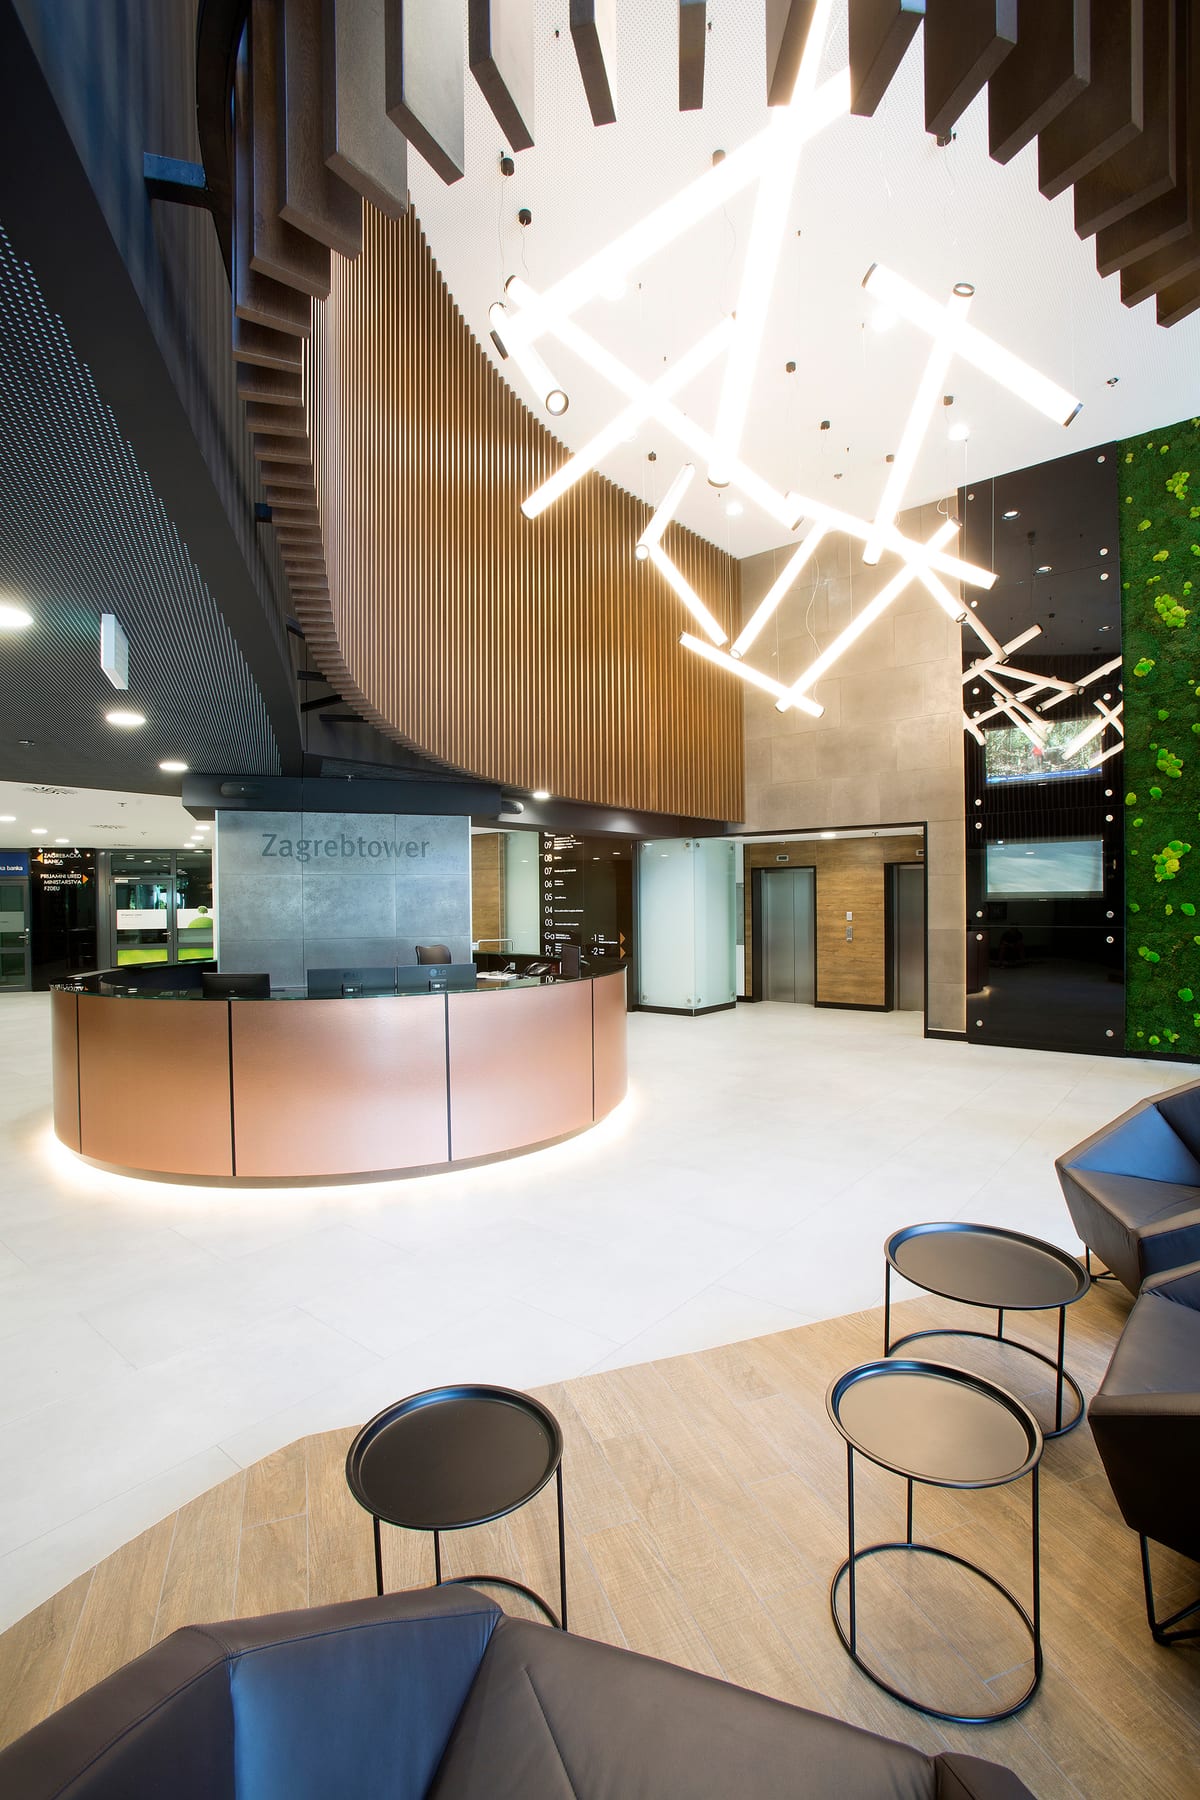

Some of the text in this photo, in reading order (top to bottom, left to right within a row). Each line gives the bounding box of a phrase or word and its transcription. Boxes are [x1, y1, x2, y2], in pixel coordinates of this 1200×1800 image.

[261, 833, 430, 863] Zagrebtower
[544, 841, 552, 849] 09
[544, 854, 552, 862] 08
[544, 867, 552, 875] 07
[545, 880, 552, 888] 06
[545, 893, 553, 901] 05
[545, 906, 553, 914] 04
[545, 919, 553, 927] 03
[544, 932, 555, 940] Ga
[545, 945, 552, 953] Pr
